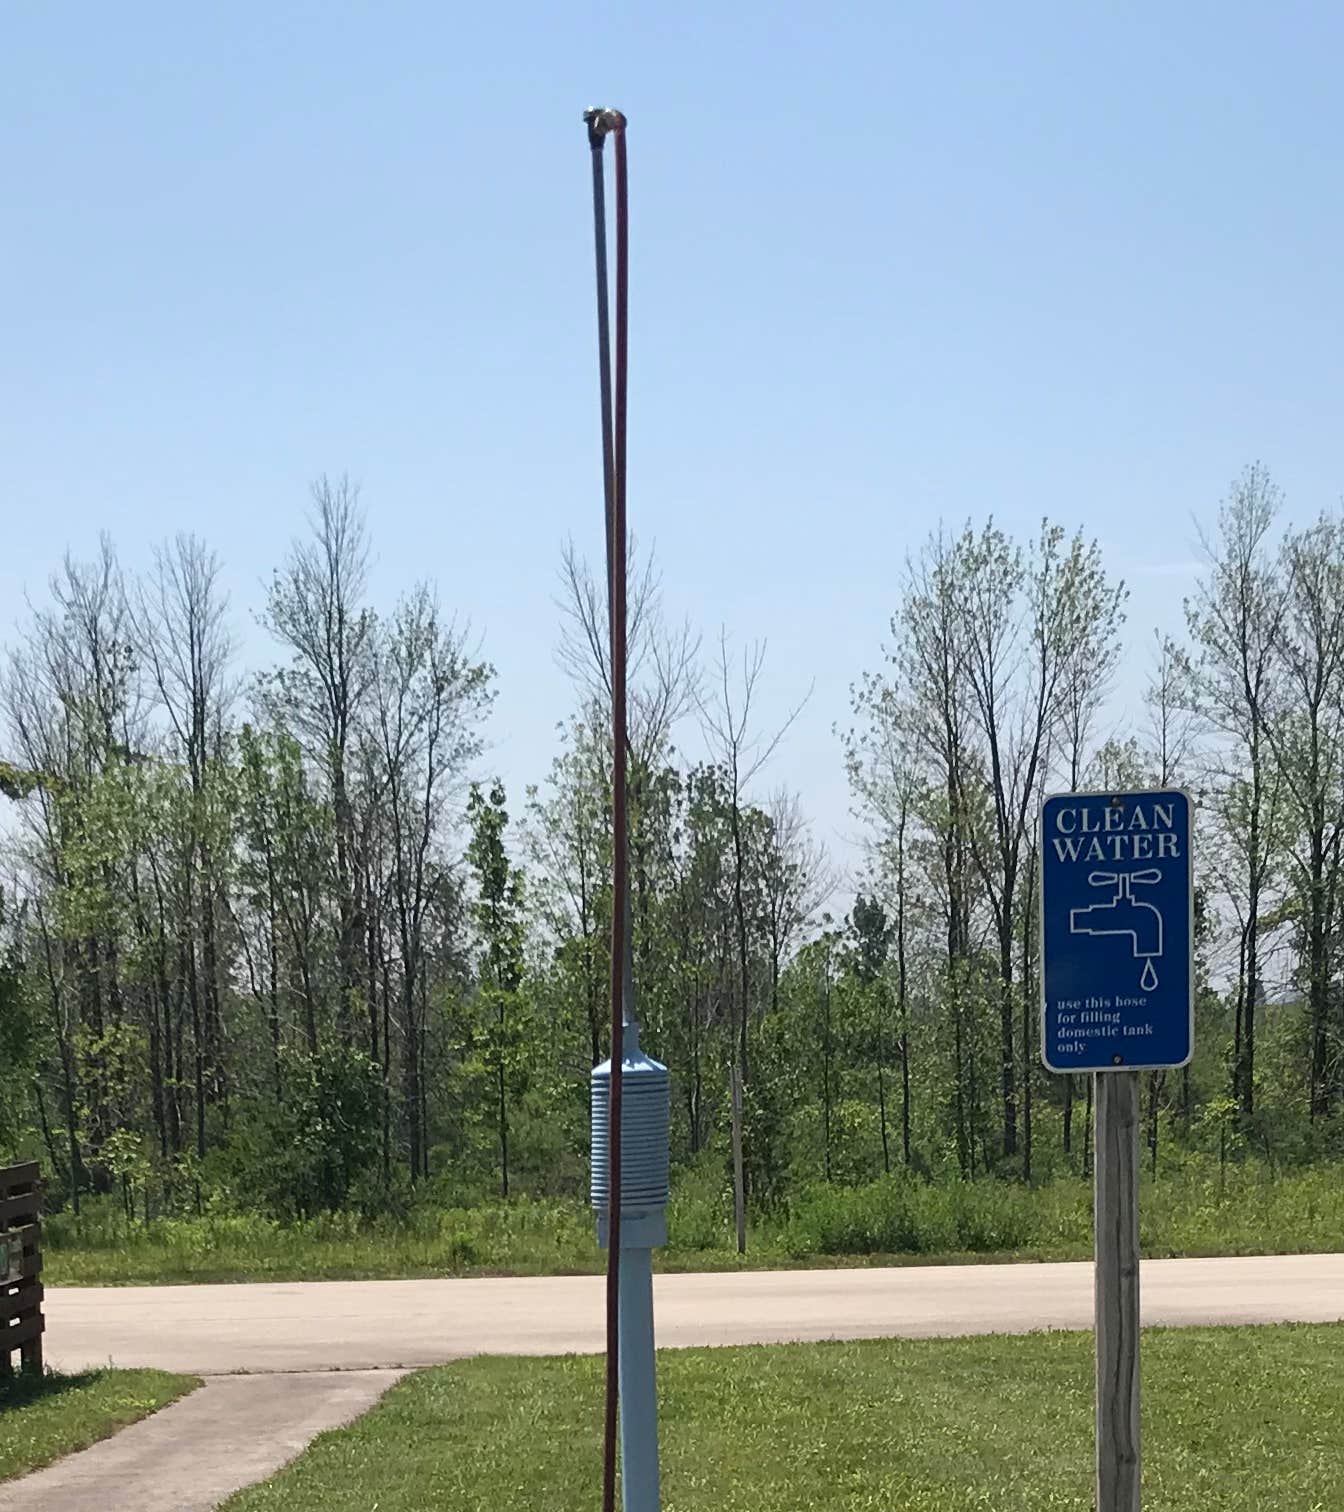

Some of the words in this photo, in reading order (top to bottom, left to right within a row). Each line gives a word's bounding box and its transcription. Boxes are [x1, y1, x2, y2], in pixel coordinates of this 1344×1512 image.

[1056, 804, 1175, 834] CLEAN
[1053, 833, 1180, 863] WATER
[1057, 1000, 1081, 1009] use
[1085, 997, 1111, 1008] this
[1115, 996, 1147, 1007] hose
[1057, 1012, 1077, 1024] for
[1080, 1011, 1121, 1024] filling
[1057, 1026, 1119, 1038] domestic
[1123, 1024, 1154, 1035] tank
[1057, 1040, 1086, 1055] only
